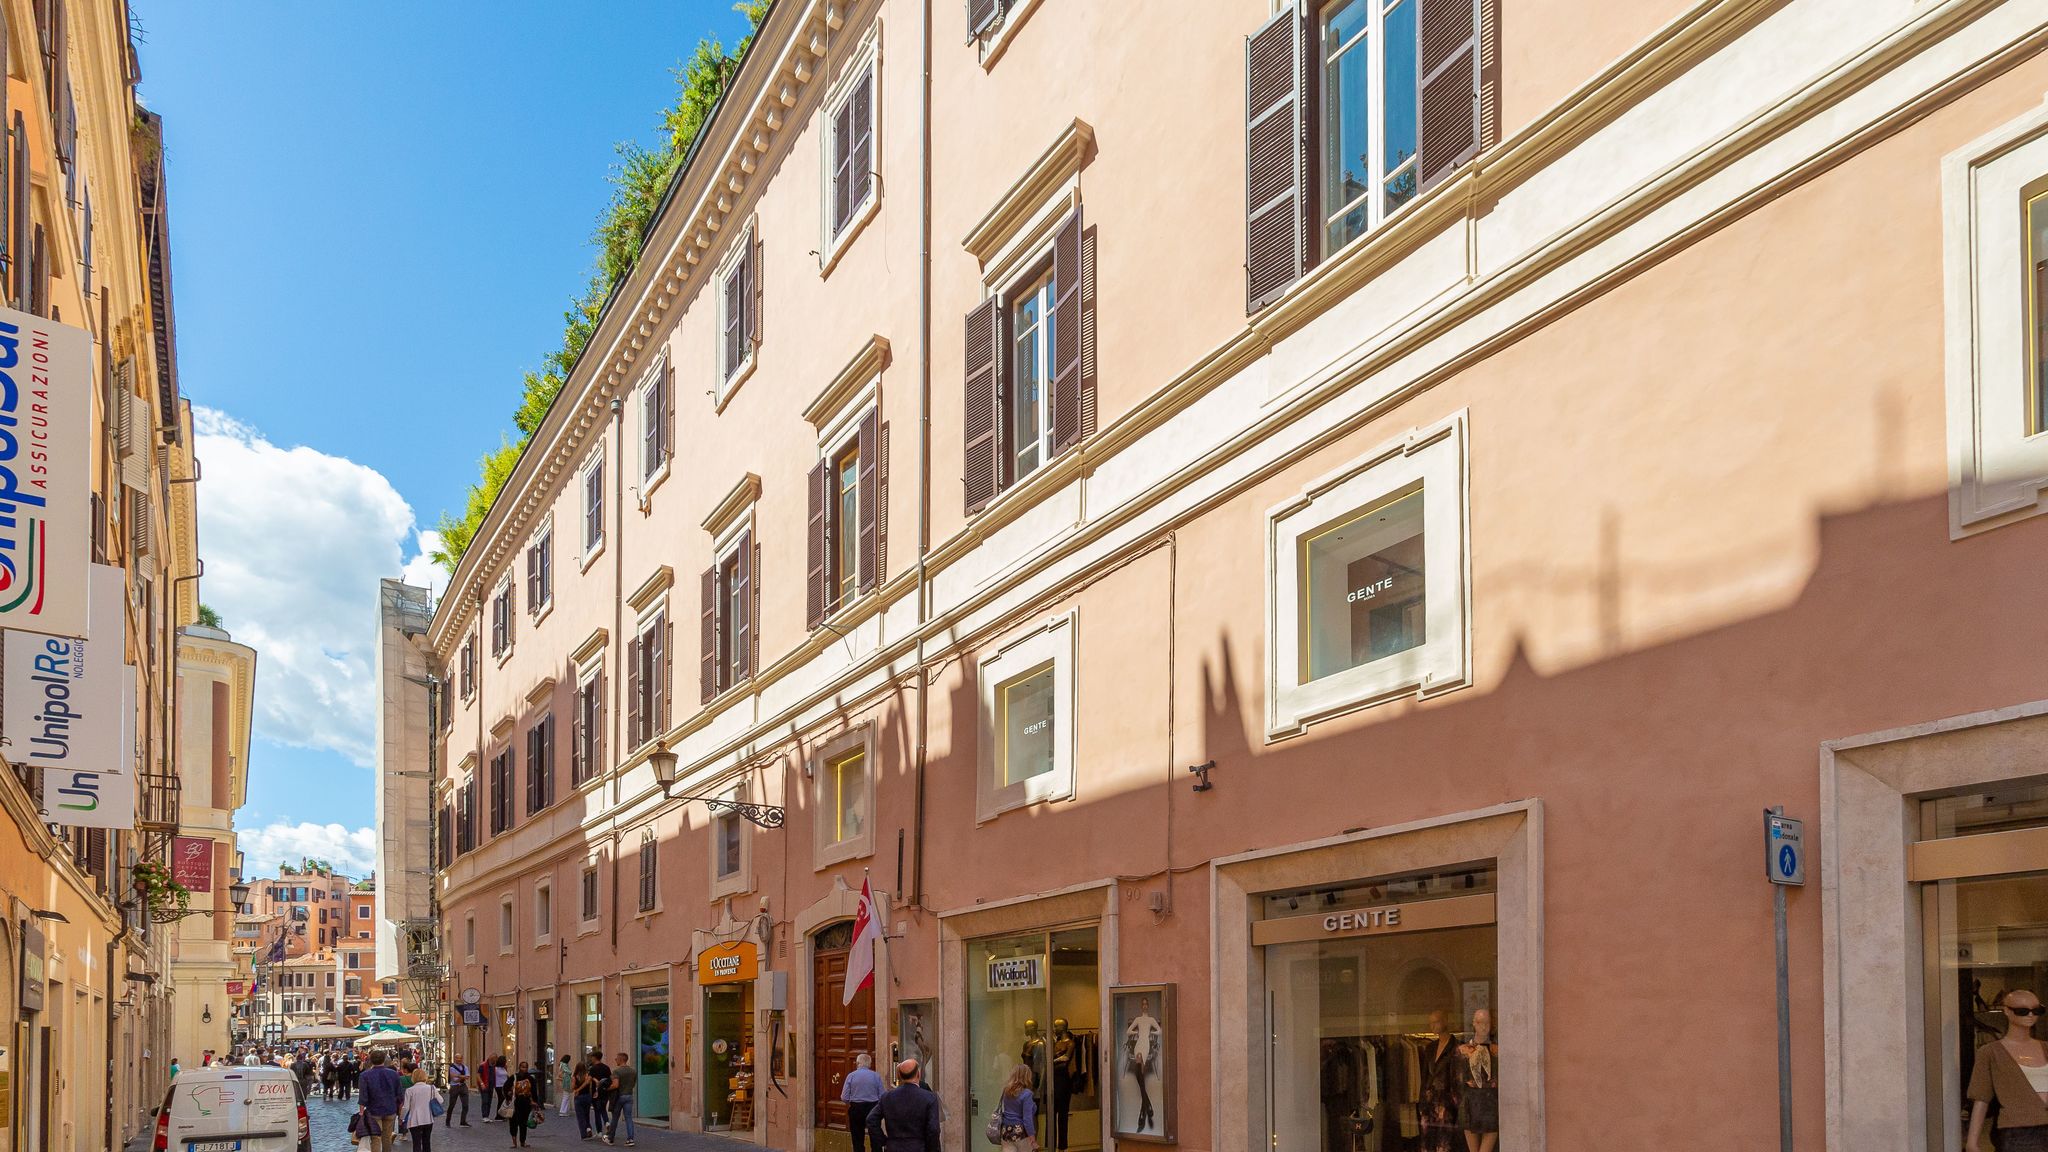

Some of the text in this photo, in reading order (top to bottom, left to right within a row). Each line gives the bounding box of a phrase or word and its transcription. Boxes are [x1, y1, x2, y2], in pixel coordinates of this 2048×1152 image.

[31, 330, 49, 489] ASSICURAZIONI
[1347, 577, 1393, 603] GENTE
[30, 636, 82, 760] UnipolRe
[1023, 720, 1047, 735] GENTE
[1126, 888, 1141, 901] 90
[1323, 909, 1400, 932] GENTE
[996, 966, 1028, 981] Wolford
[258, 1084, 289, 1095] EXON
